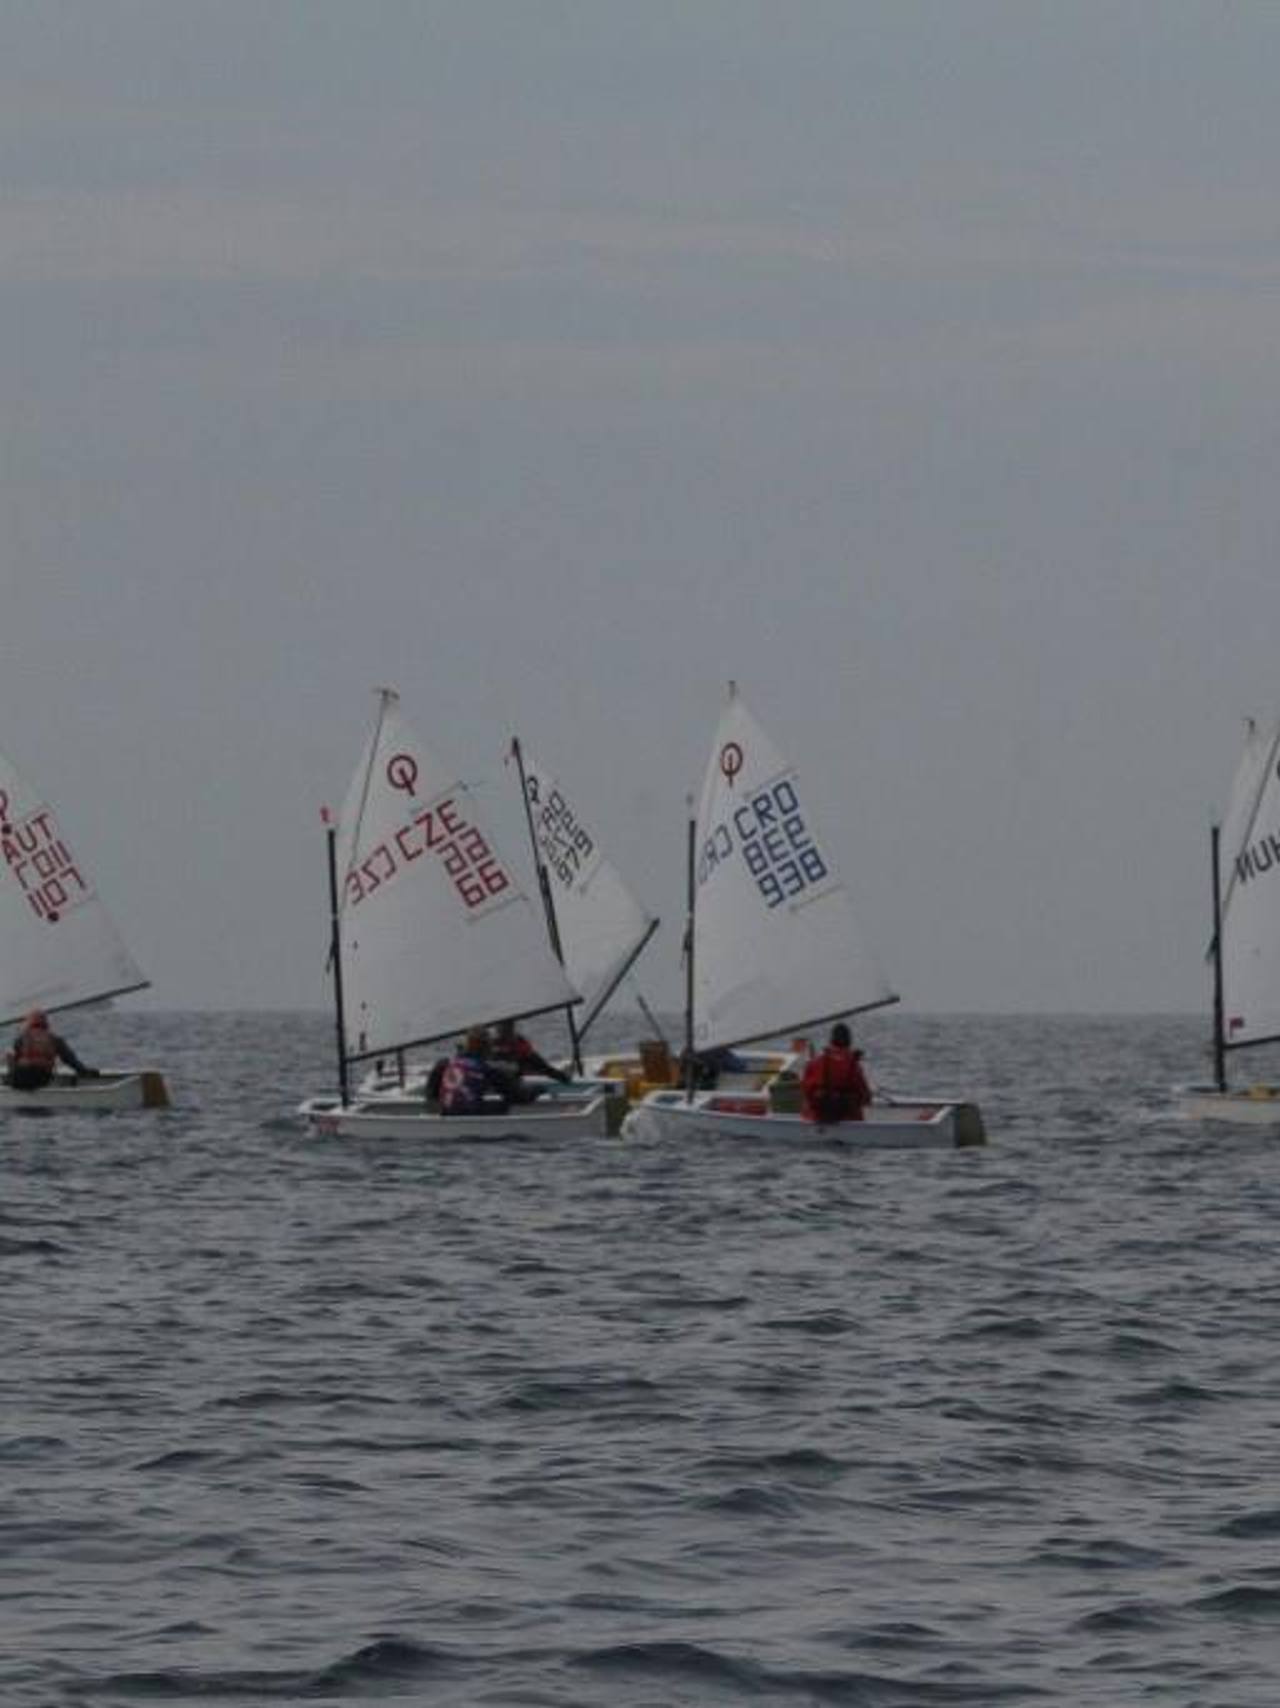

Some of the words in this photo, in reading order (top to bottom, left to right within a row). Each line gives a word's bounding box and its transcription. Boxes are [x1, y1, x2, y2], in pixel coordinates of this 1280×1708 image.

[2, 813, 52, 864] AUT
[395, 799, 467, 861] CZE
[733, 780, 799, 840] CRO
[455, 861, 510, 908] 66
[757, 848, 827, 908] 938
